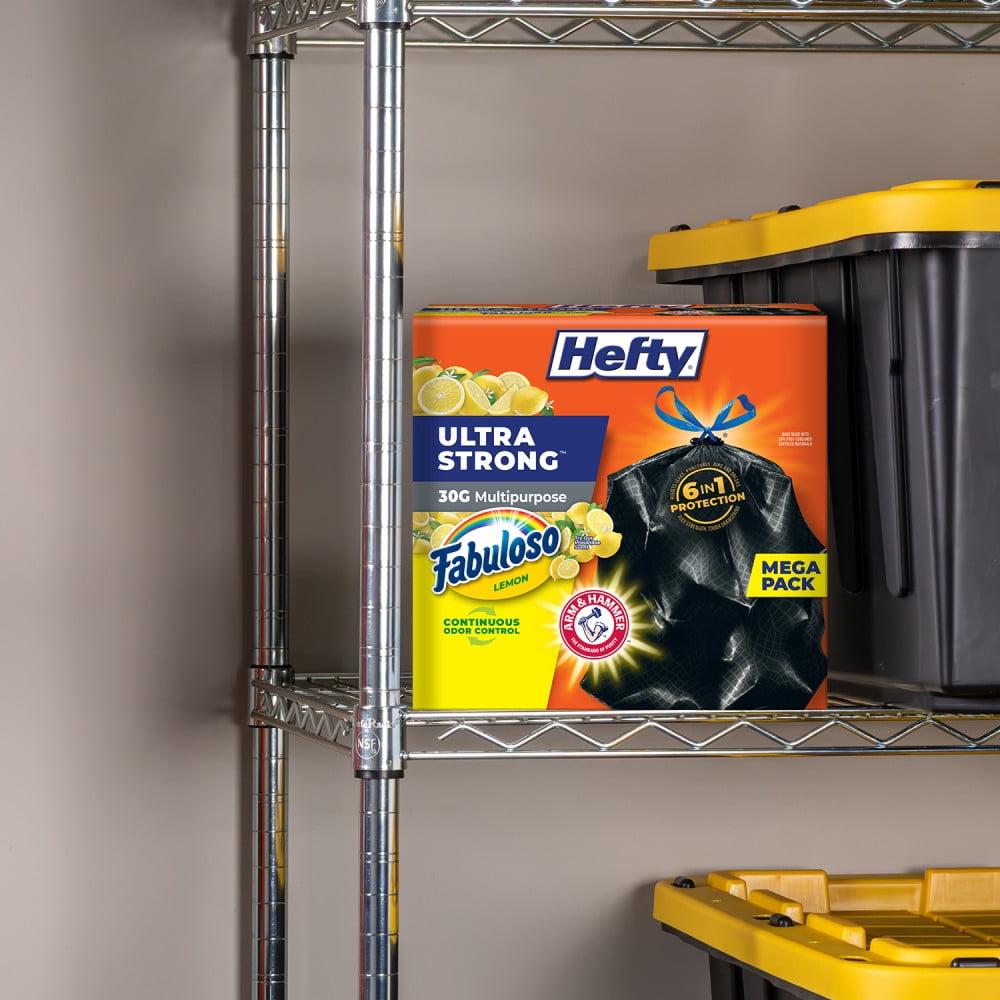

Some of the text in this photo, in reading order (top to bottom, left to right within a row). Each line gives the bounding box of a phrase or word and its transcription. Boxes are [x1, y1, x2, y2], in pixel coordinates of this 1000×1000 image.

[558, 336, 697, 378] Hefty
[438, 426, 536, 447] ULTRA
[438, 489, 567, 506] 30G Multipurpose
[682, 476, 726, 500] 6 IN 1
[670, 491, 746, 513] PROTECTION
[430, 526, 560, 593] Fabuloso
[762, 560, 822, 575] MEGA
[493, 573, 529, 592] LEMON
[762, 577, 815, 591] PACK
[563, 594, 625, 631] ARM & HAMMER
[443, 618, 520, 627] CONTINUOUS
[443, 627, 520, 635] ODOR CONTROL
[357, 738, 377, 750] NSF
